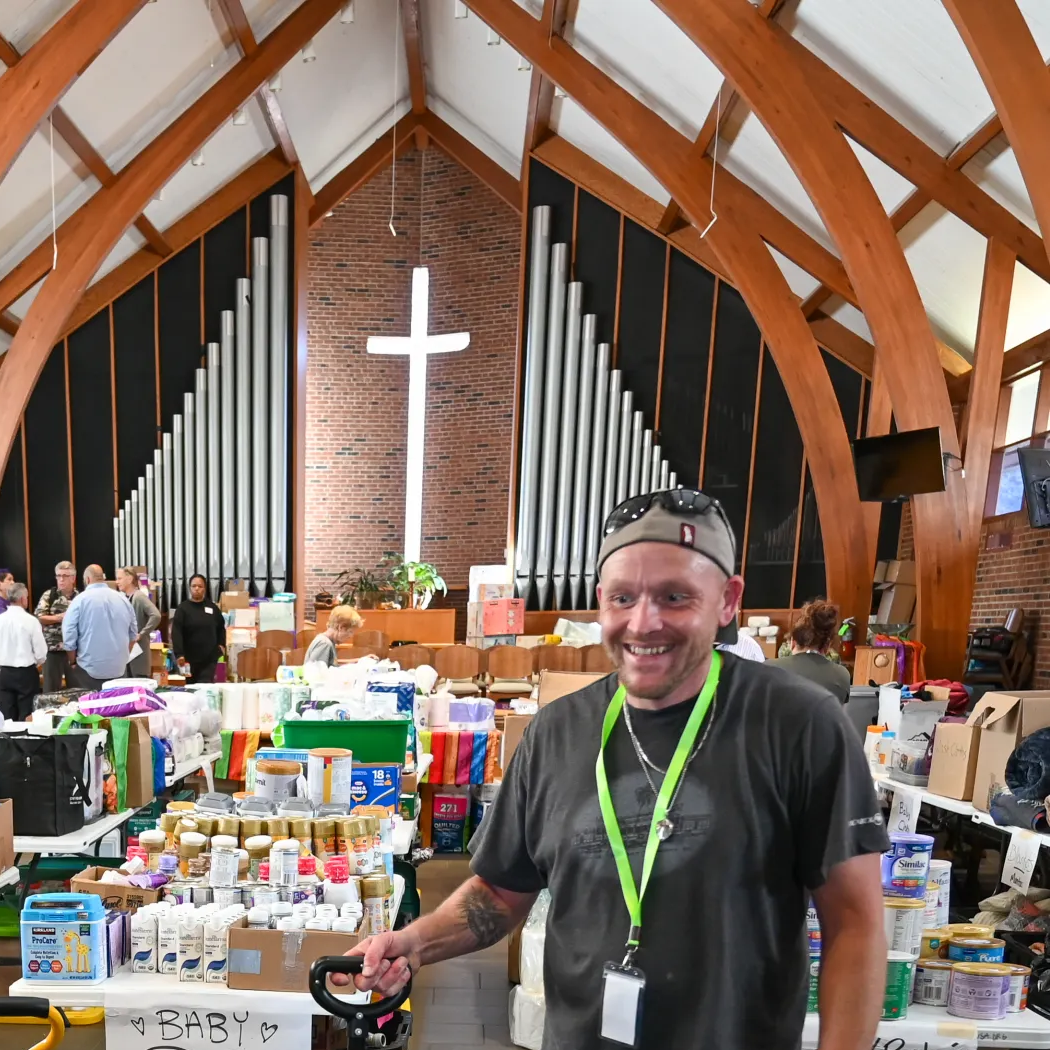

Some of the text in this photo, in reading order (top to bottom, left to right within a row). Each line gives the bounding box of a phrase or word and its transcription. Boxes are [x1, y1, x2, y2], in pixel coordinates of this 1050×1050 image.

[372, 770, 385, 779] 18
[440, 803, 458, 813] 271
[898, 859, 926, 868] Similac
[31, 936, 57, 944] ProCare
[155, 1009, 250, 1047] BABY
